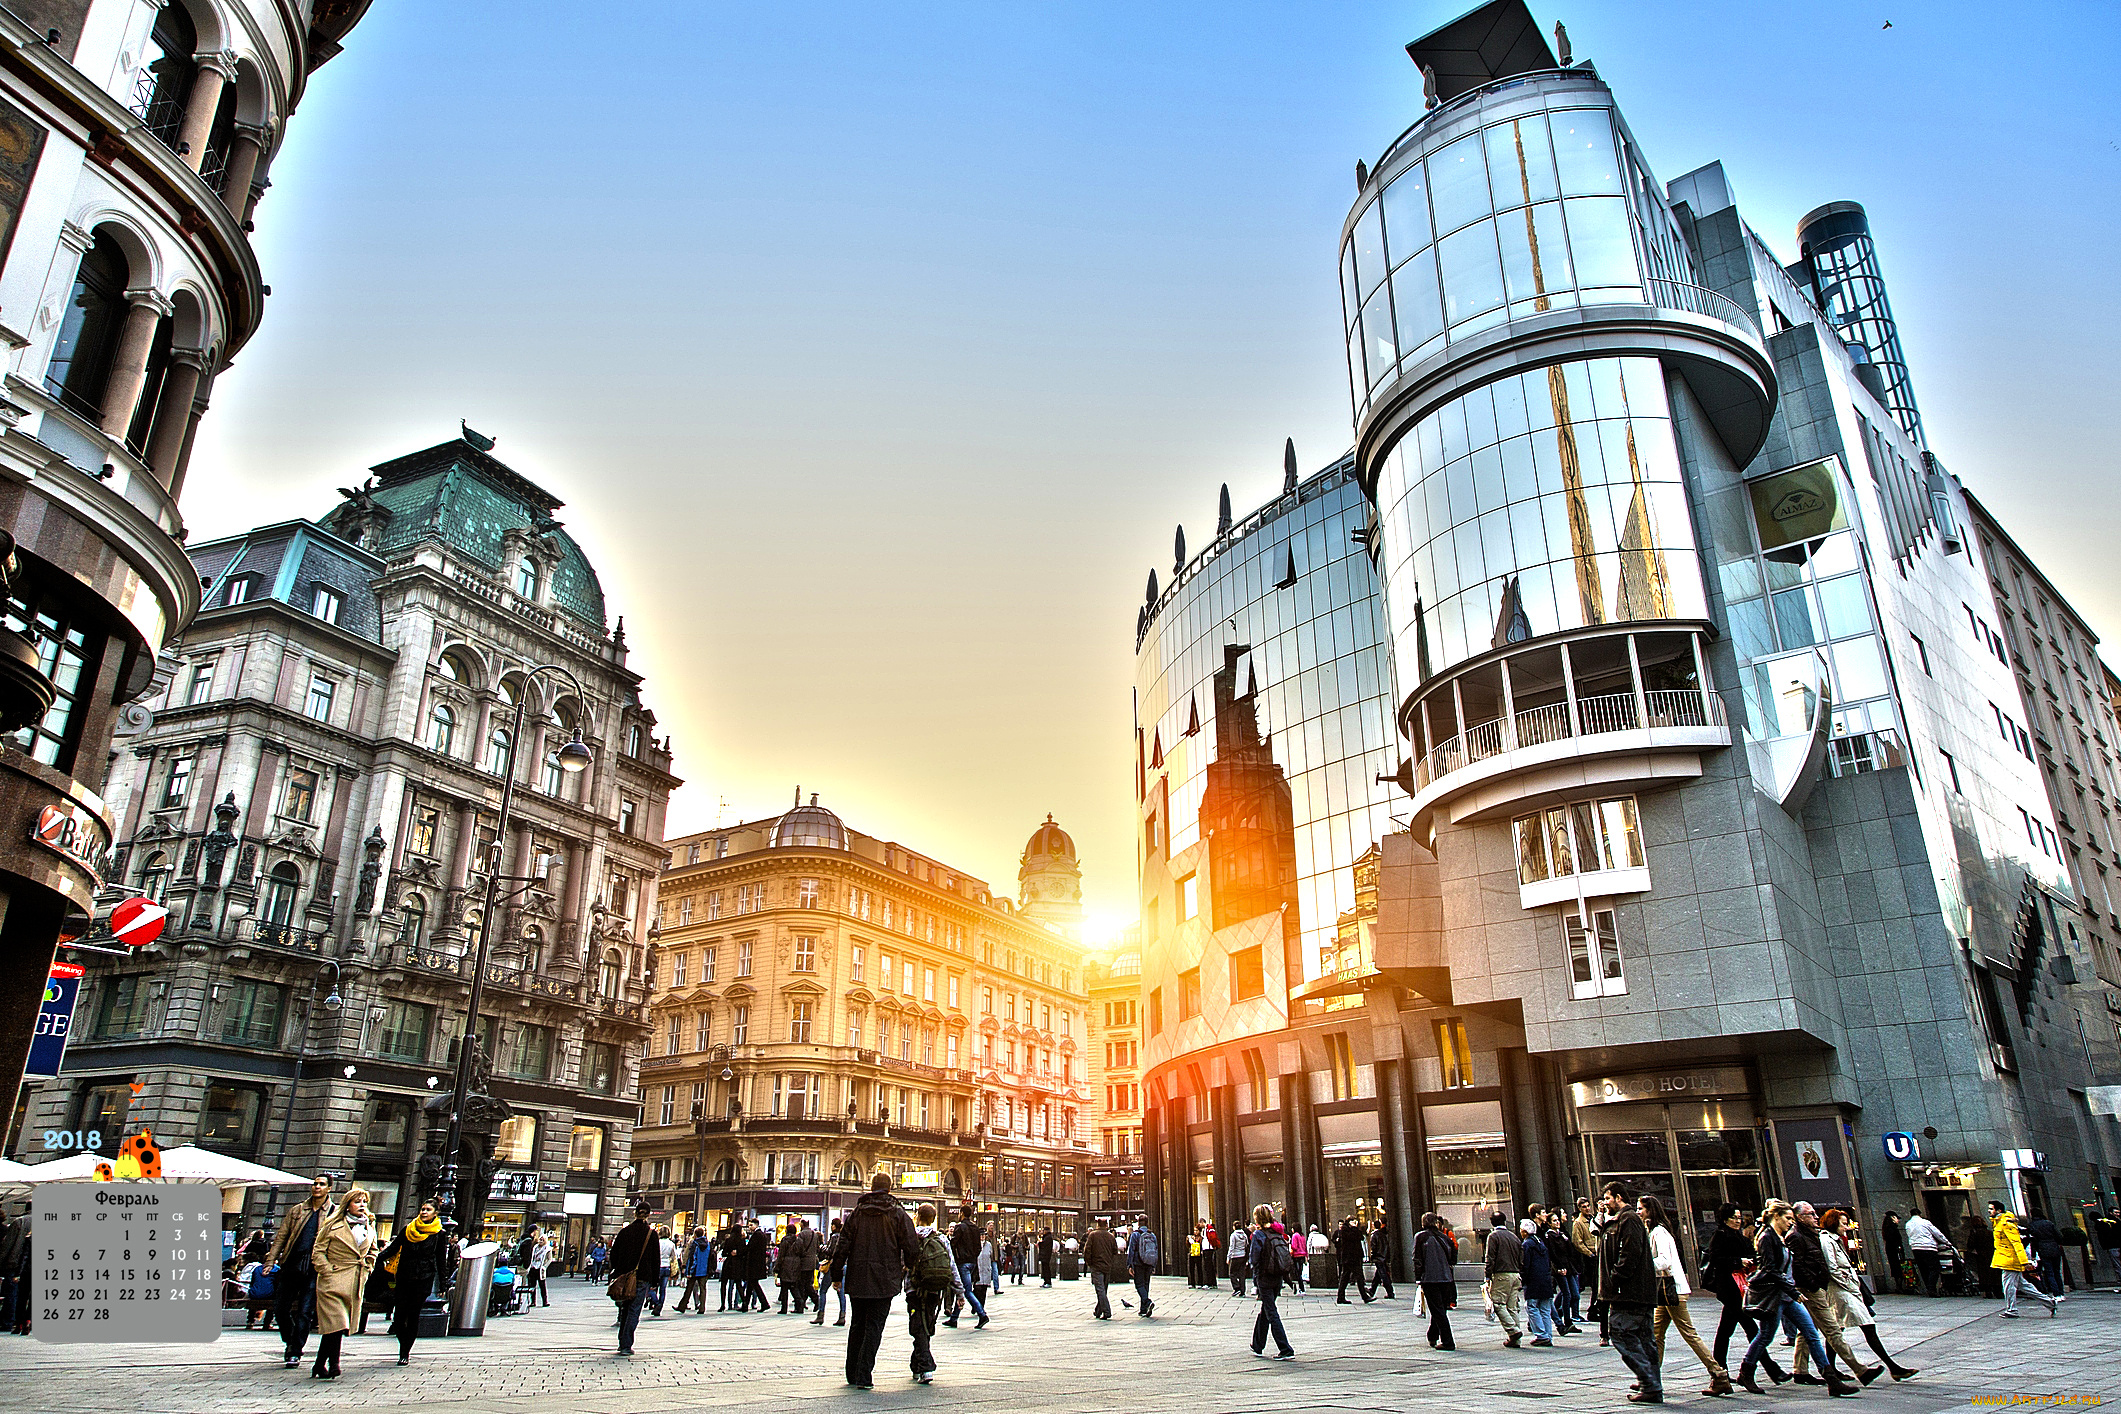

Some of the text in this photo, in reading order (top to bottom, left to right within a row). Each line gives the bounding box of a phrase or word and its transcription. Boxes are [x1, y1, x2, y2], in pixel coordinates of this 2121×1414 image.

[1780, 499, 1819, 516] ALMAZ
[1659, 1074, 1720, 1092] HOTEL
[1886, 1138, 1910, 1159] U
